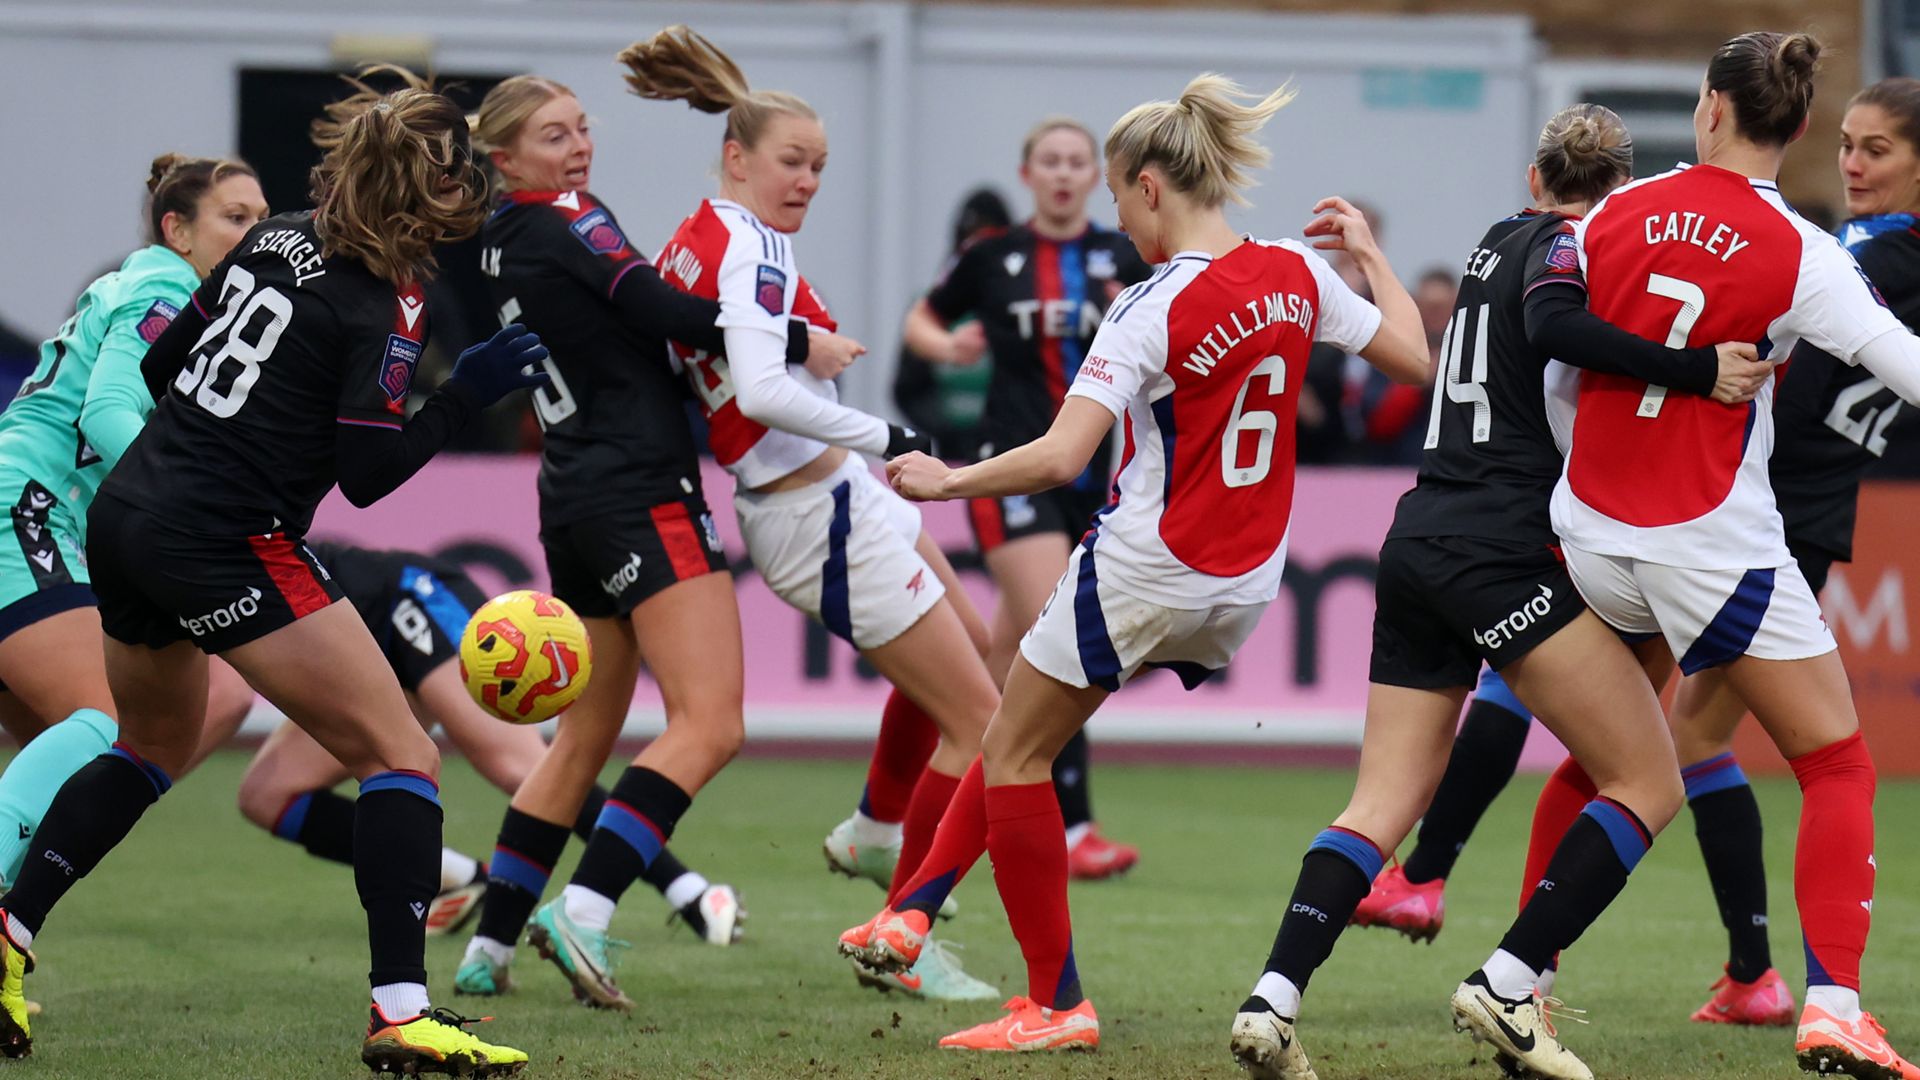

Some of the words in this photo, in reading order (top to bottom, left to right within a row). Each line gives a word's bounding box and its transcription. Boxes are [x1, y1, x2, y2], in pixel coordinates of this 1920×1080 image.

[251, 229, 327, 288] STENGEL
[1645, 211, 1749, 263] CATLEY
[174, 263, 294, 419] 28
[1423, 303, 1492, 450] 14
[1636, 272, 1705, 419] 7
[1221, 354, 1286, 489] 6
[44, 849, 74, 876] CPFC
[1292, 903, 1328, 923] CPFC
